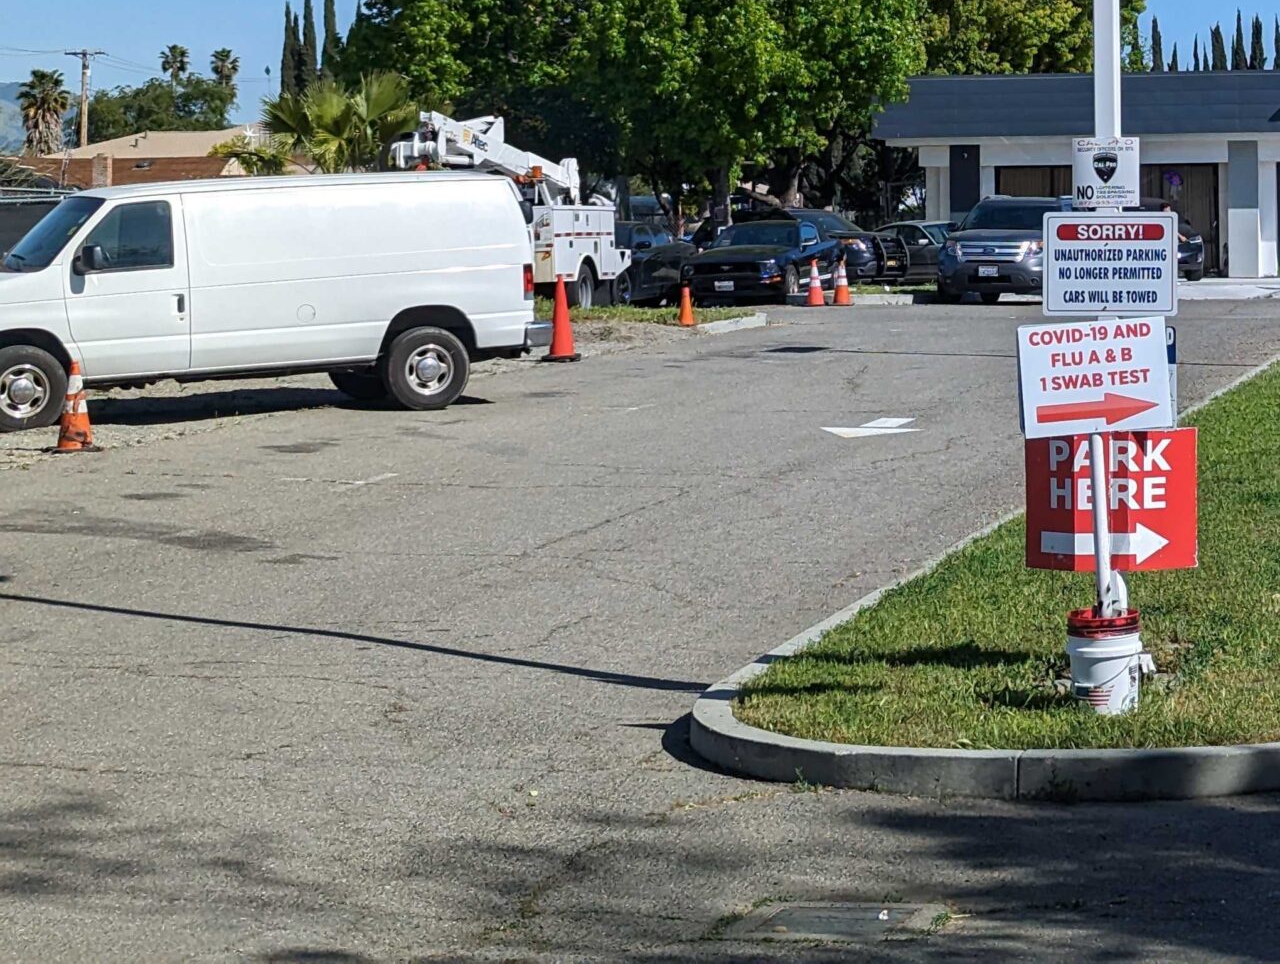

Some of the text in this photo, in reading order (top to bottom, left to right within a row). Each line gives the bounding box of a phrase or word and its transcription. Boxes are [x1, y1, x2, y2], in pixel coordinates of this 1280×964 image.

[1077, 185, 1094, 200] NO
[1077, 225, 1143, 239] SORRY!
[1054, 249, 1167, 262] UNAUTHORIZED PARKING
[1058, 267, 1162, 280] NO LONGER PERMITTED
[1063, 291, 1158, 303] CARS WILL BE TOWED
[1028, 323, 1151, 347] COVID-19 AND
[1051, 347, 1133, 368] FLU A & B
[1040, 368, 1151, 392] 1 SWAB TEST
[1050, 439, 1171, 471] PARK
[1050, 477, 1167, 510] HERE
